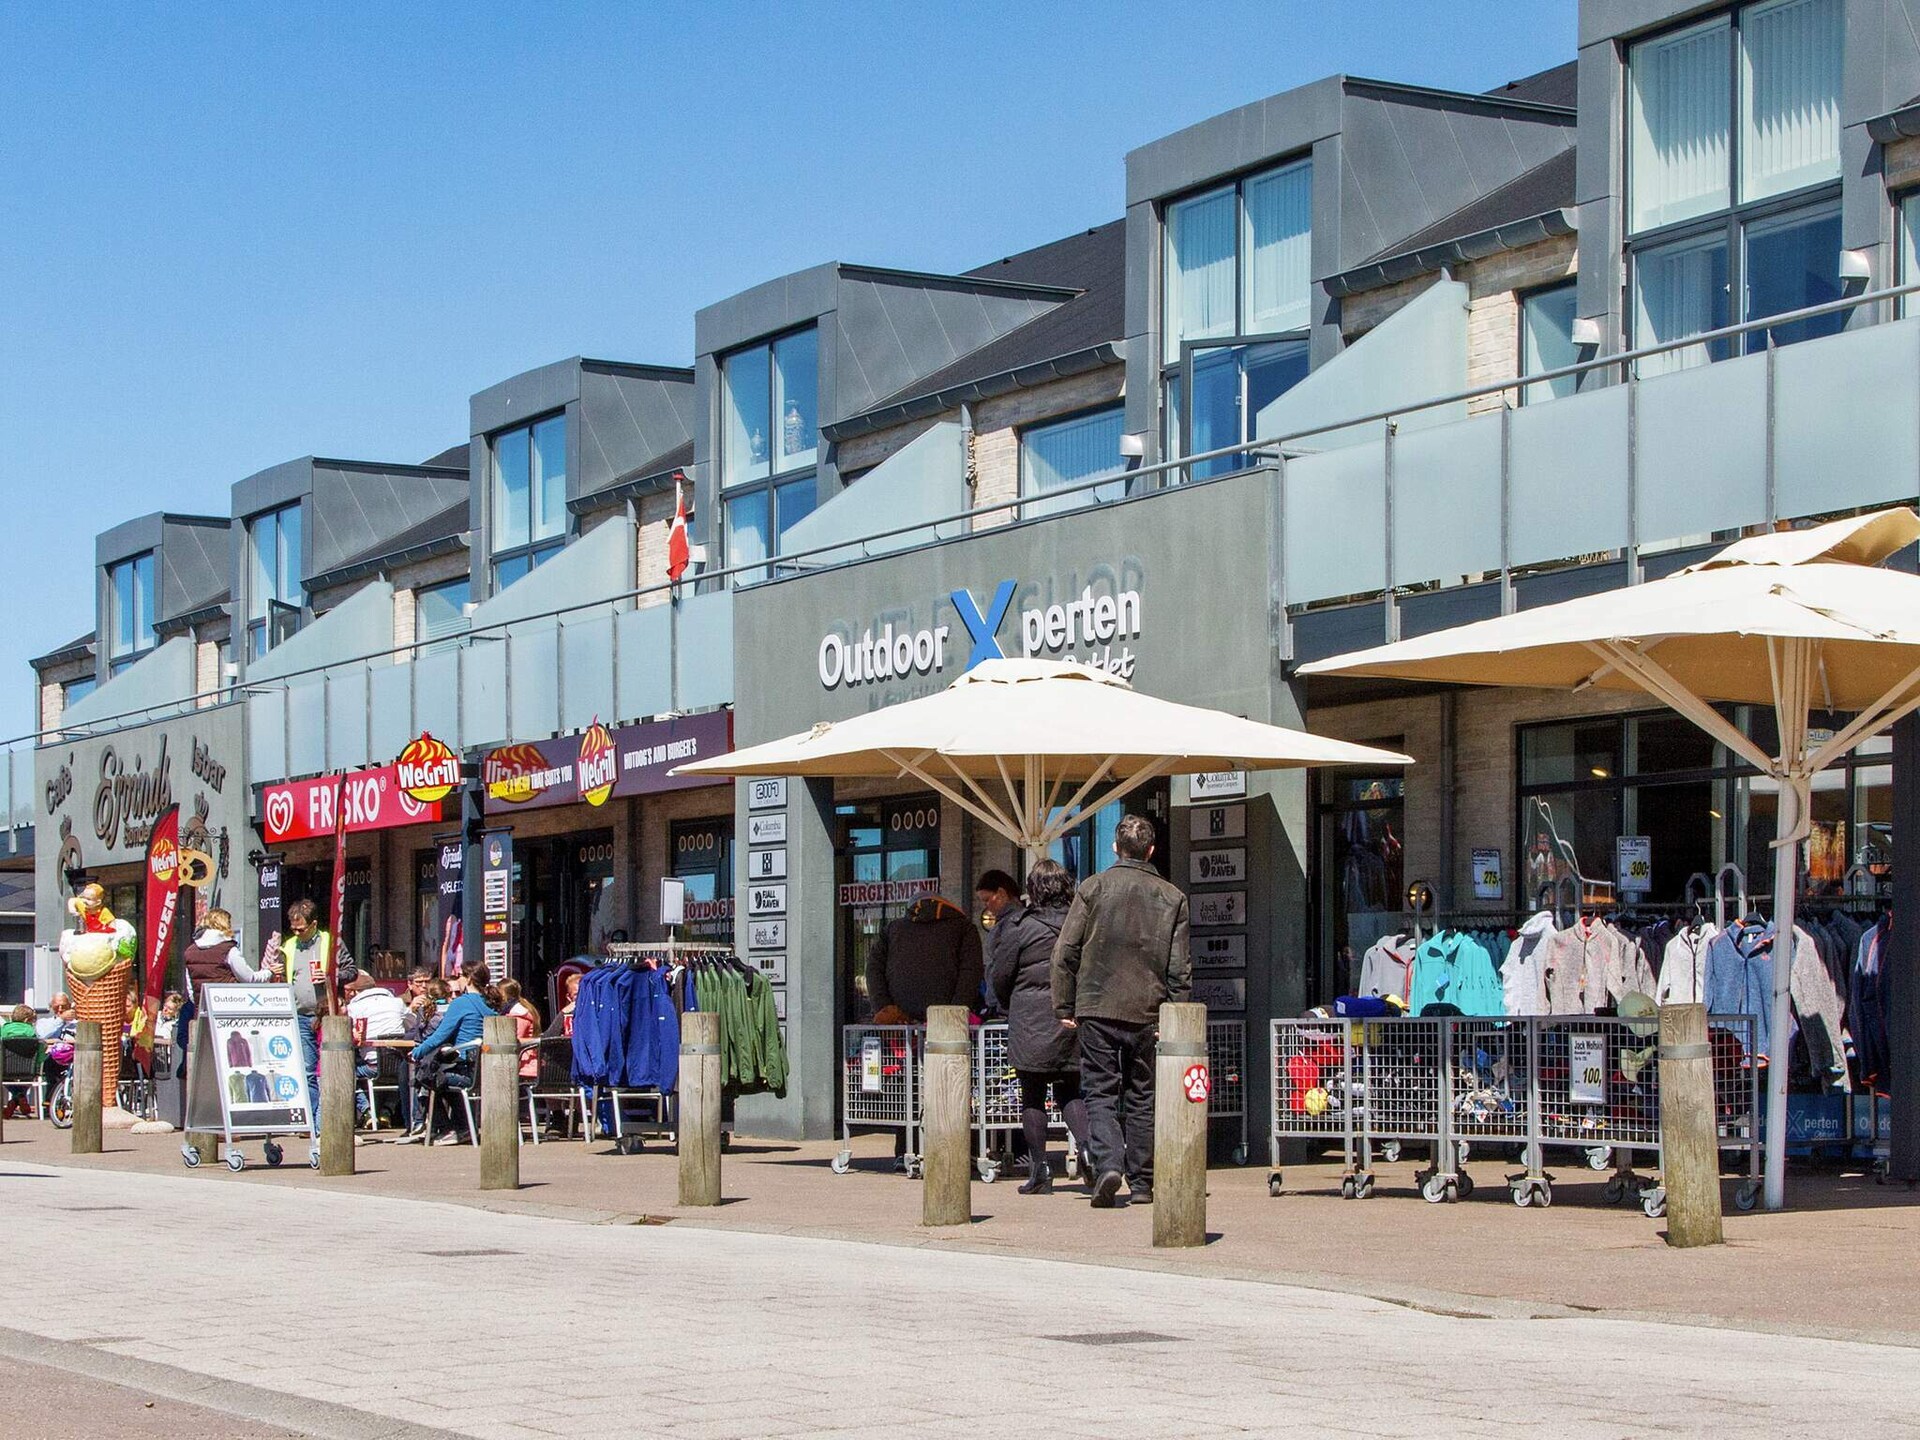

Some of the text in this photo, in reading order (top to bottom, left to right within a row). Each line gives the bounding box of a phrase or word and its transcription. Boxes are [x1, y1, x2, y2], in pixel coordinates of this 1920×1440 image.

[818, 625, 950, 689] Outdoor
[950, 577, 1017, 671] X
[1022, 585, 1141, 659] perten
[191, 735, 227, 794] Isbar
[397, 758, 460, 789] WeGrill
[577, 748, 617, 792] WeGrill
[531, 772, 544, 790] THAT
[544, 768, 561, 787] SUITS
[561, 765, 574, 783] YOU
[309, 777, 380, 829] FRISKO
[152, 849, 177, 874] WeGrill
[840, 883, 895, 904] BURGER
[213, 995, 246, 1003] Outdoor
[247, 993, 263, 1007] X
[263, 995, 288, 1004] perten
[251, 1018, 291, 1028] JACKETS
[1574, 1041, 1585, 1050] Jack
[1804, 1117, 1839, 1131] perten
